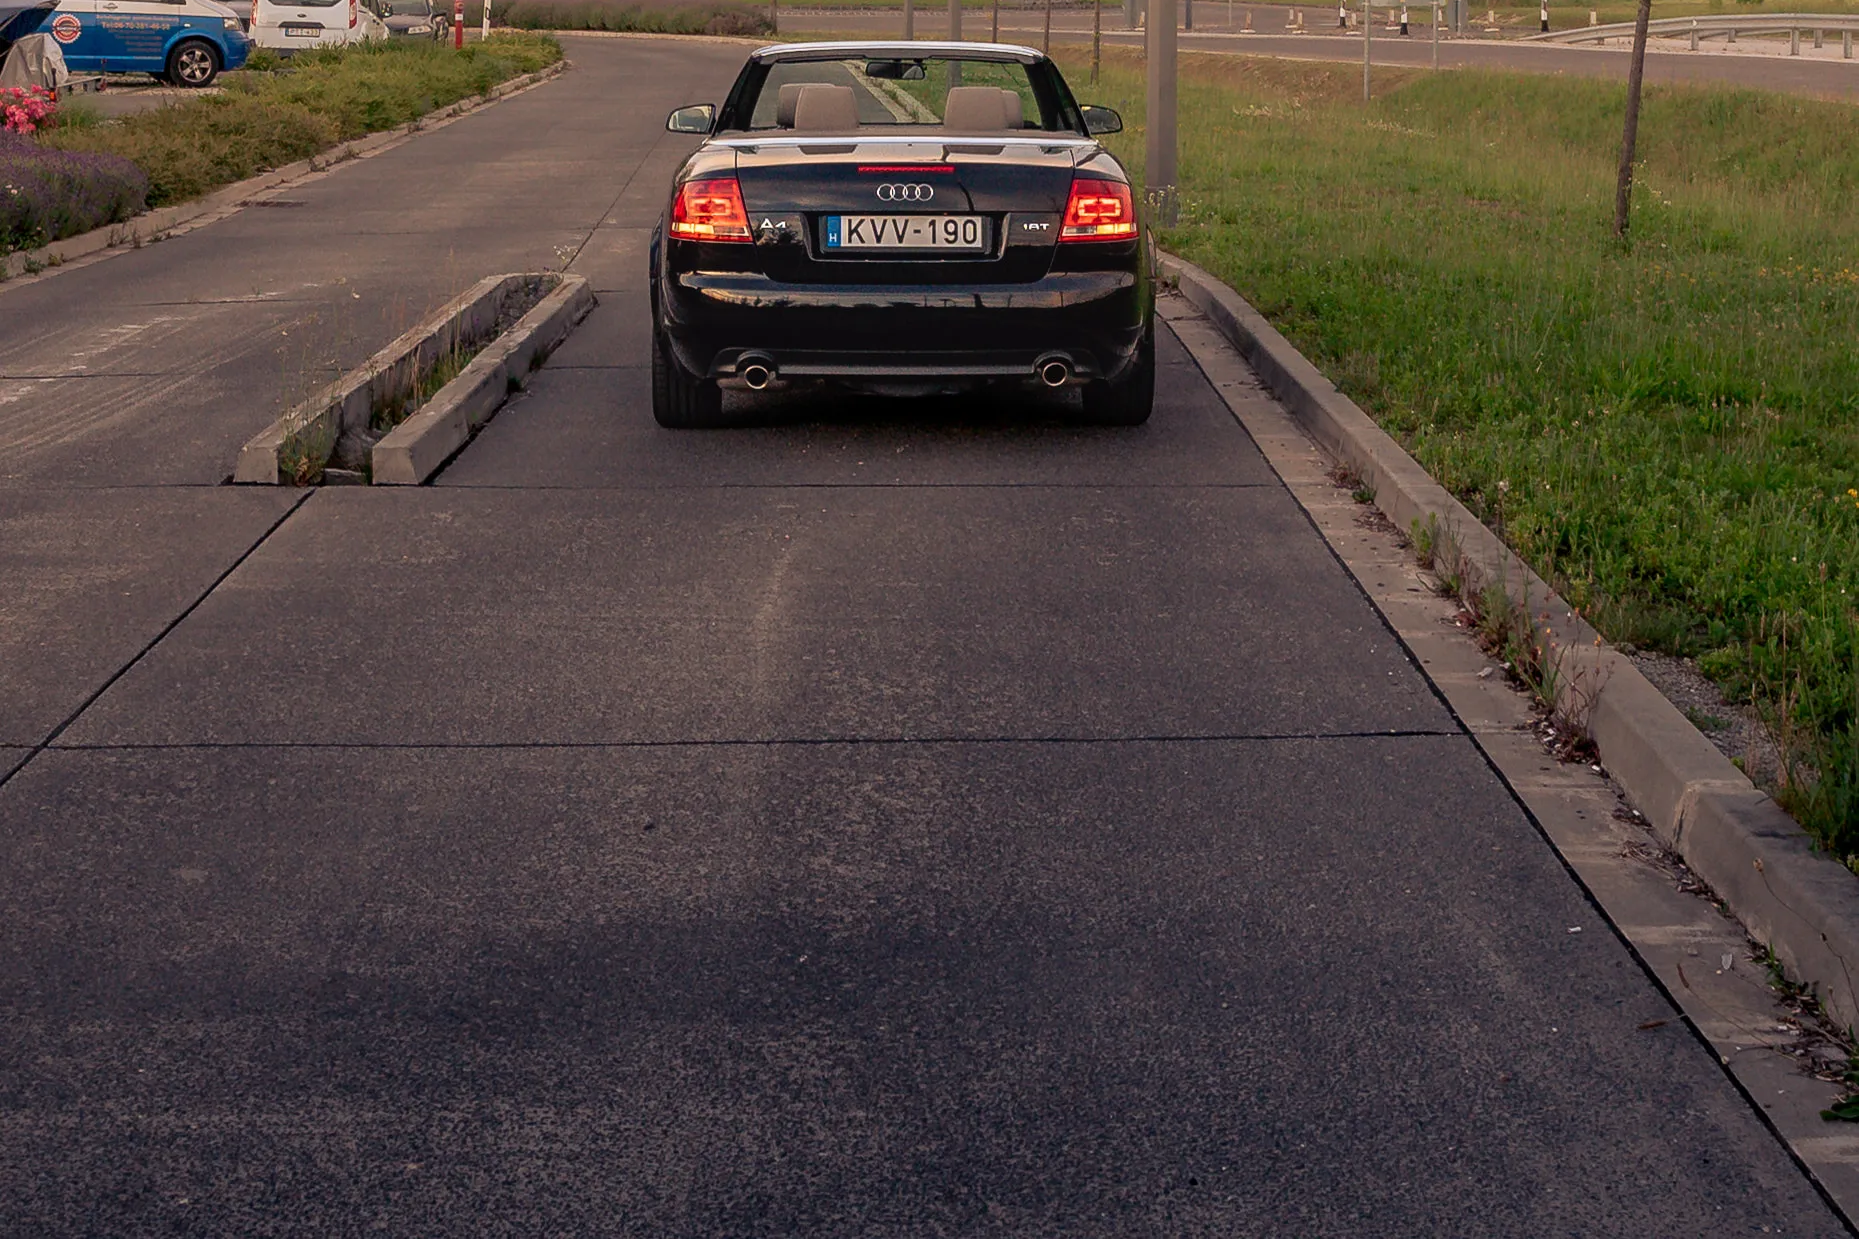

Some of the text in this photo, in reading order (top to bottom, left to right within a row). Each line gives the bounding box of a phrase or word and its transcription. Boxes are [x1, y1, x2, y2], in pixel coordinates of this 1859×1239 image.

[759, 217, 786, 231] A4
[829, 218, 977, 244] H KVV-190
